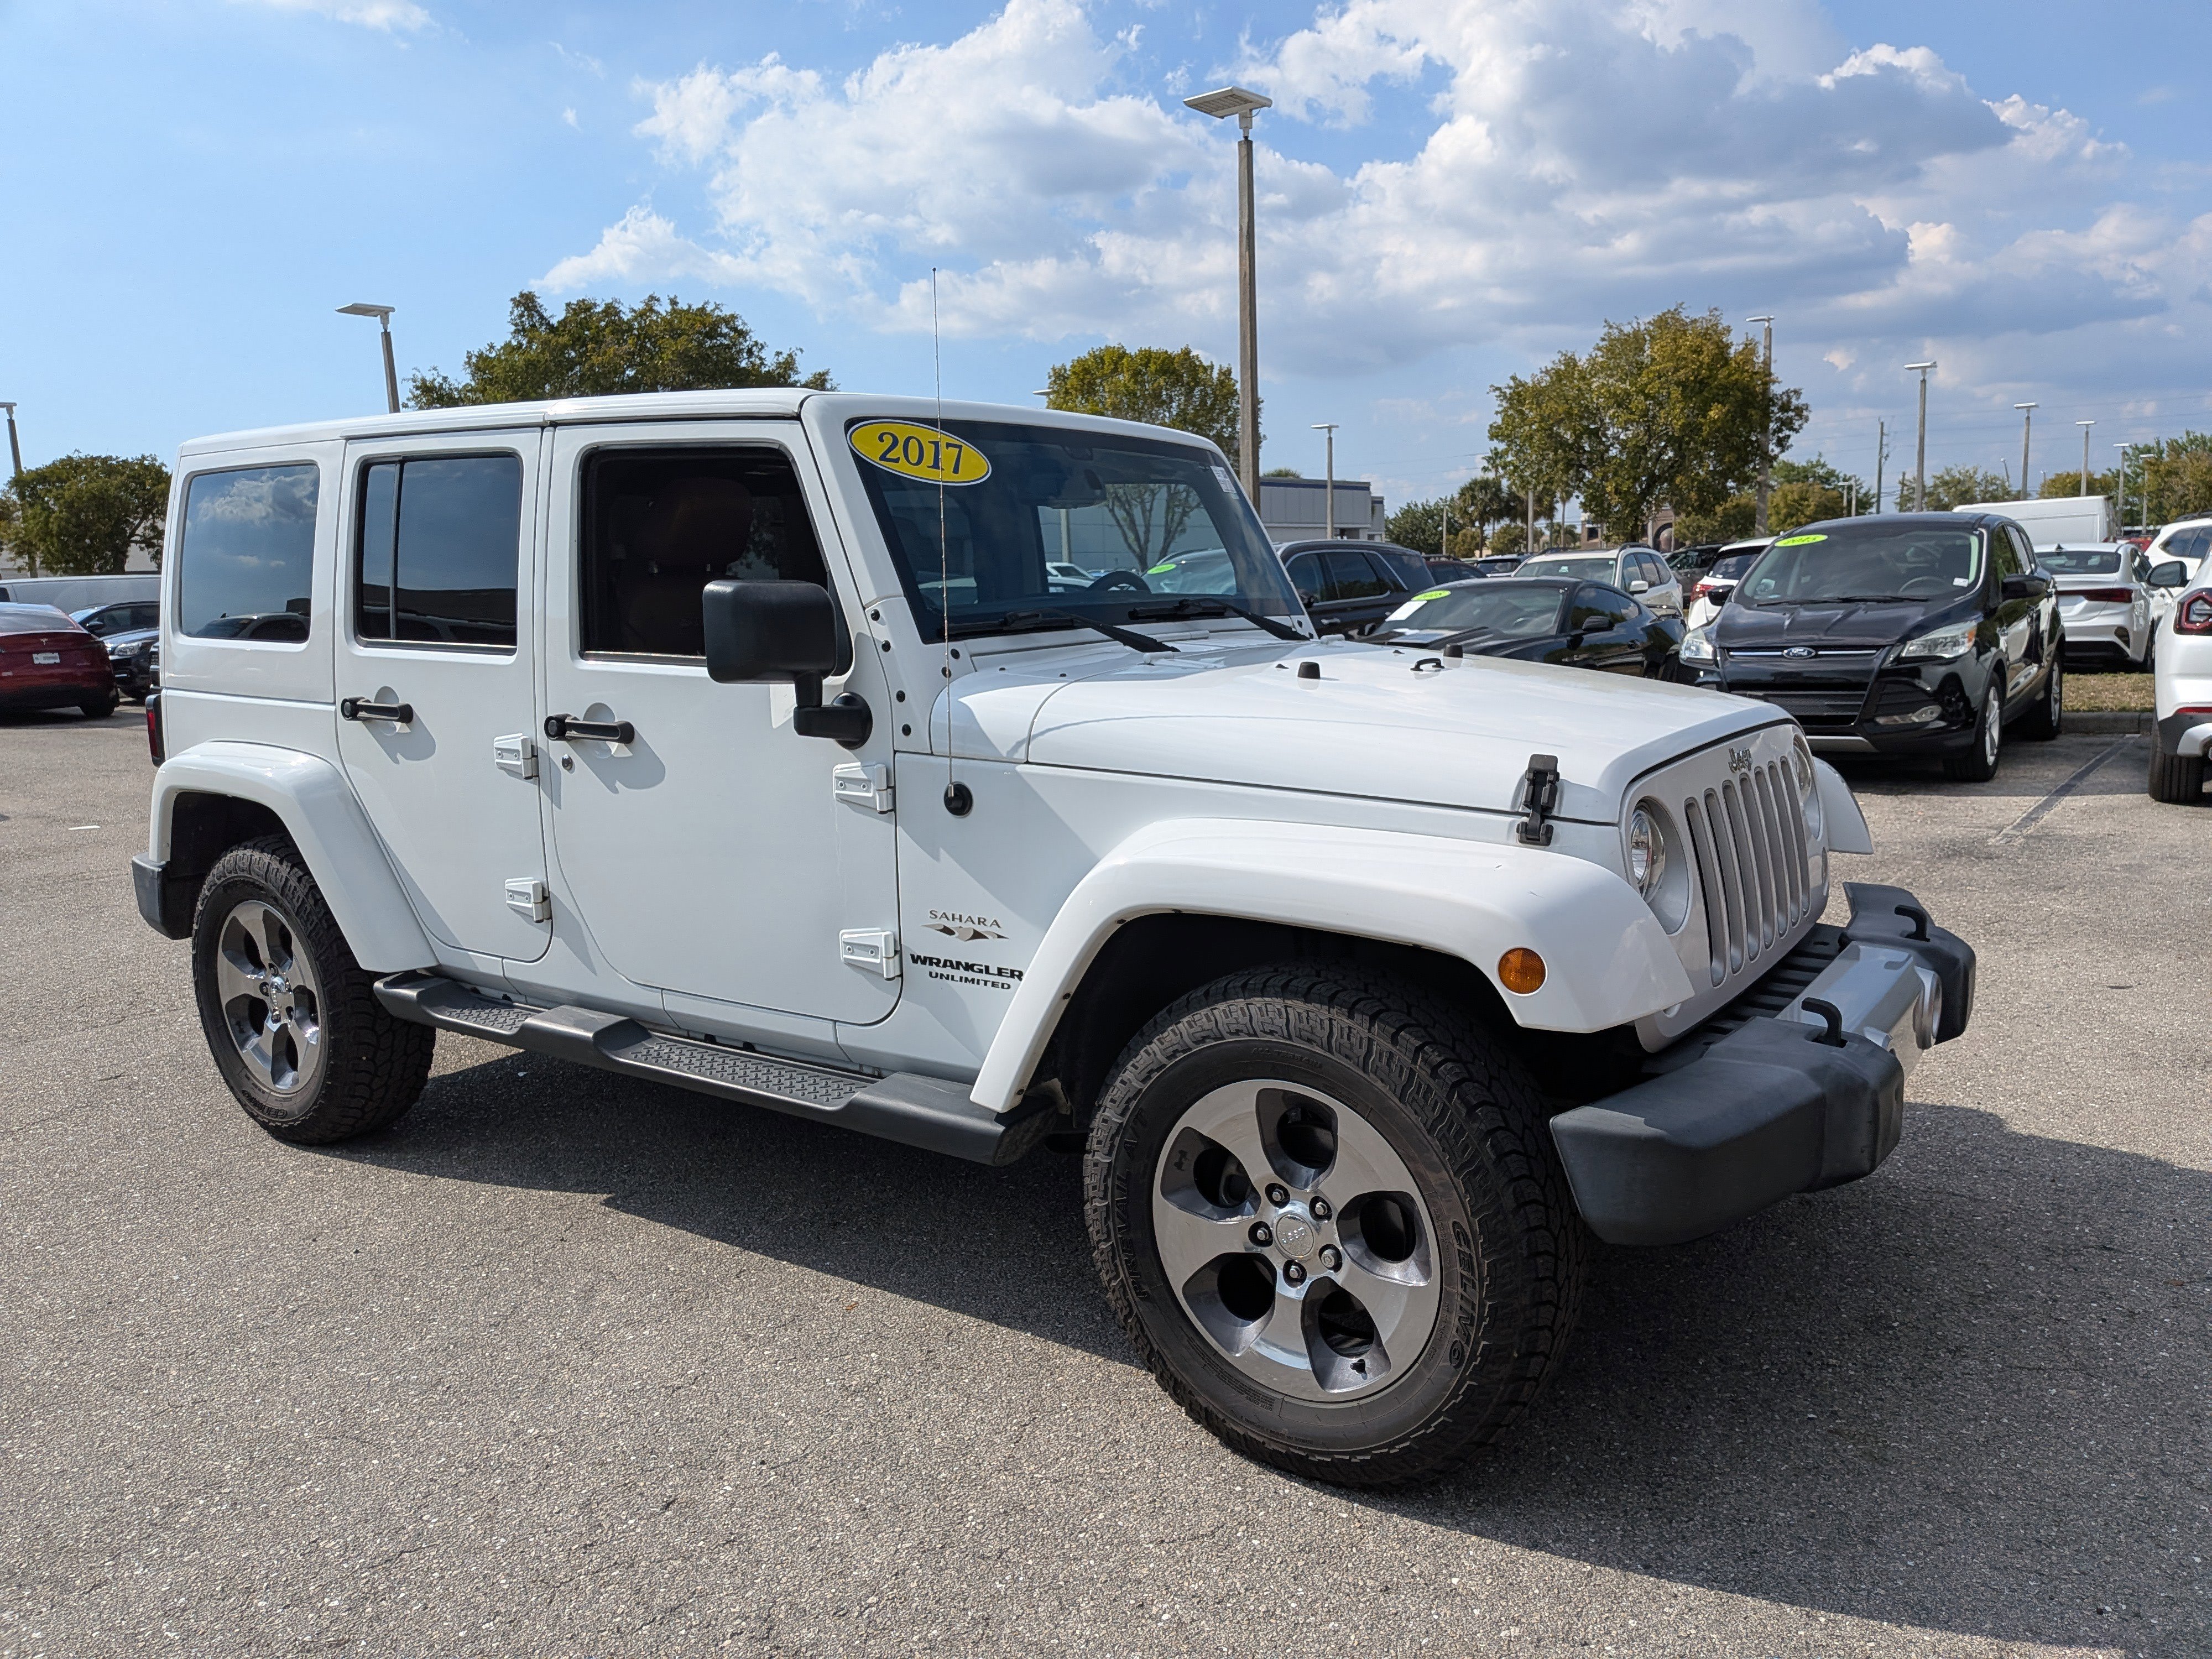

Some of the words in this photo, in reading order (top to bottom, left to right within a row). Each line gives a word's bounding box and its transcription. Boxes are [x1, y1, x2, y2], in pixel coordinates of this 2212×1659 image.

[878, 431, 963, 474] 2017
[1728, 747, 1753, 774] Jeep
[929, 910, 1001, 928] SAHARA
[910, 953, 1024, 982] WRANGLER
[928, 971, 1011, 990] UNLIMITED
[1115, 1168, 1149, 1300] PREVAIL
[1449, 1220, 1479, 1370] CELIMO
